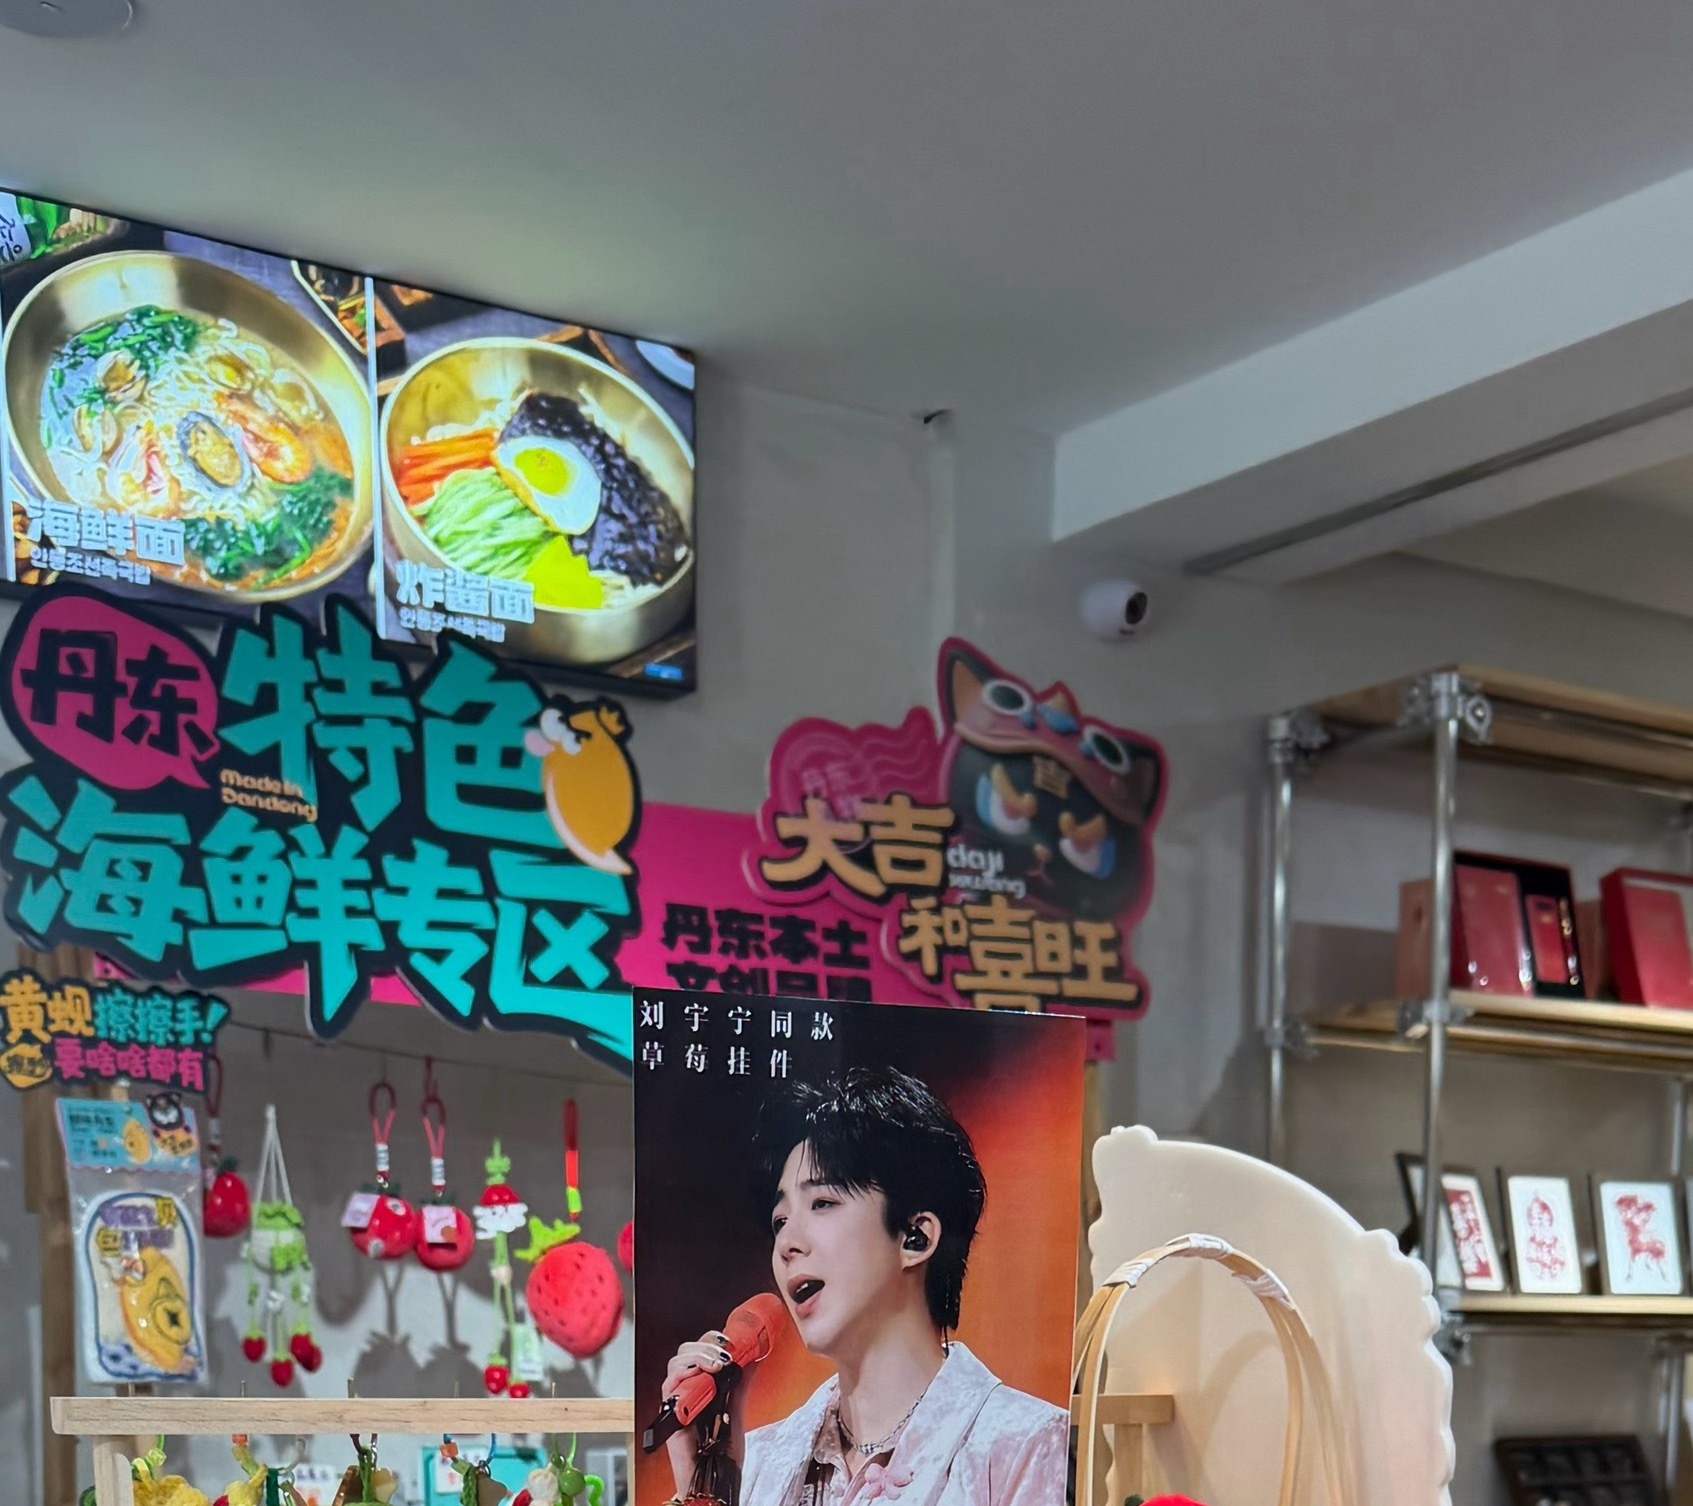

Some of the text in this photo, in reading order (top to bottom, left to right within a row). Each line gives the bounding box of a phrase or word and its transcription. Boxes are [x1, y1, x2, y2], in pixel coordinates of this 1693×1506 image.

[27, 500, 186, 565] 海鲜面
[21, 628, 215, 756] 丹东
[217, 603, 574, 850] 特色
[761, 794, 955, 897] 大吉
[9, 775, 634, 1062] 海鲜专区
[660, 903, 873, 969] 丹东本土
[899, 895, 1140, 1011] 和喜旺
[639, 1000, 834, 1041] 刘宇宁同款
[641, 1041, 793, 1079] 草莓挂件
